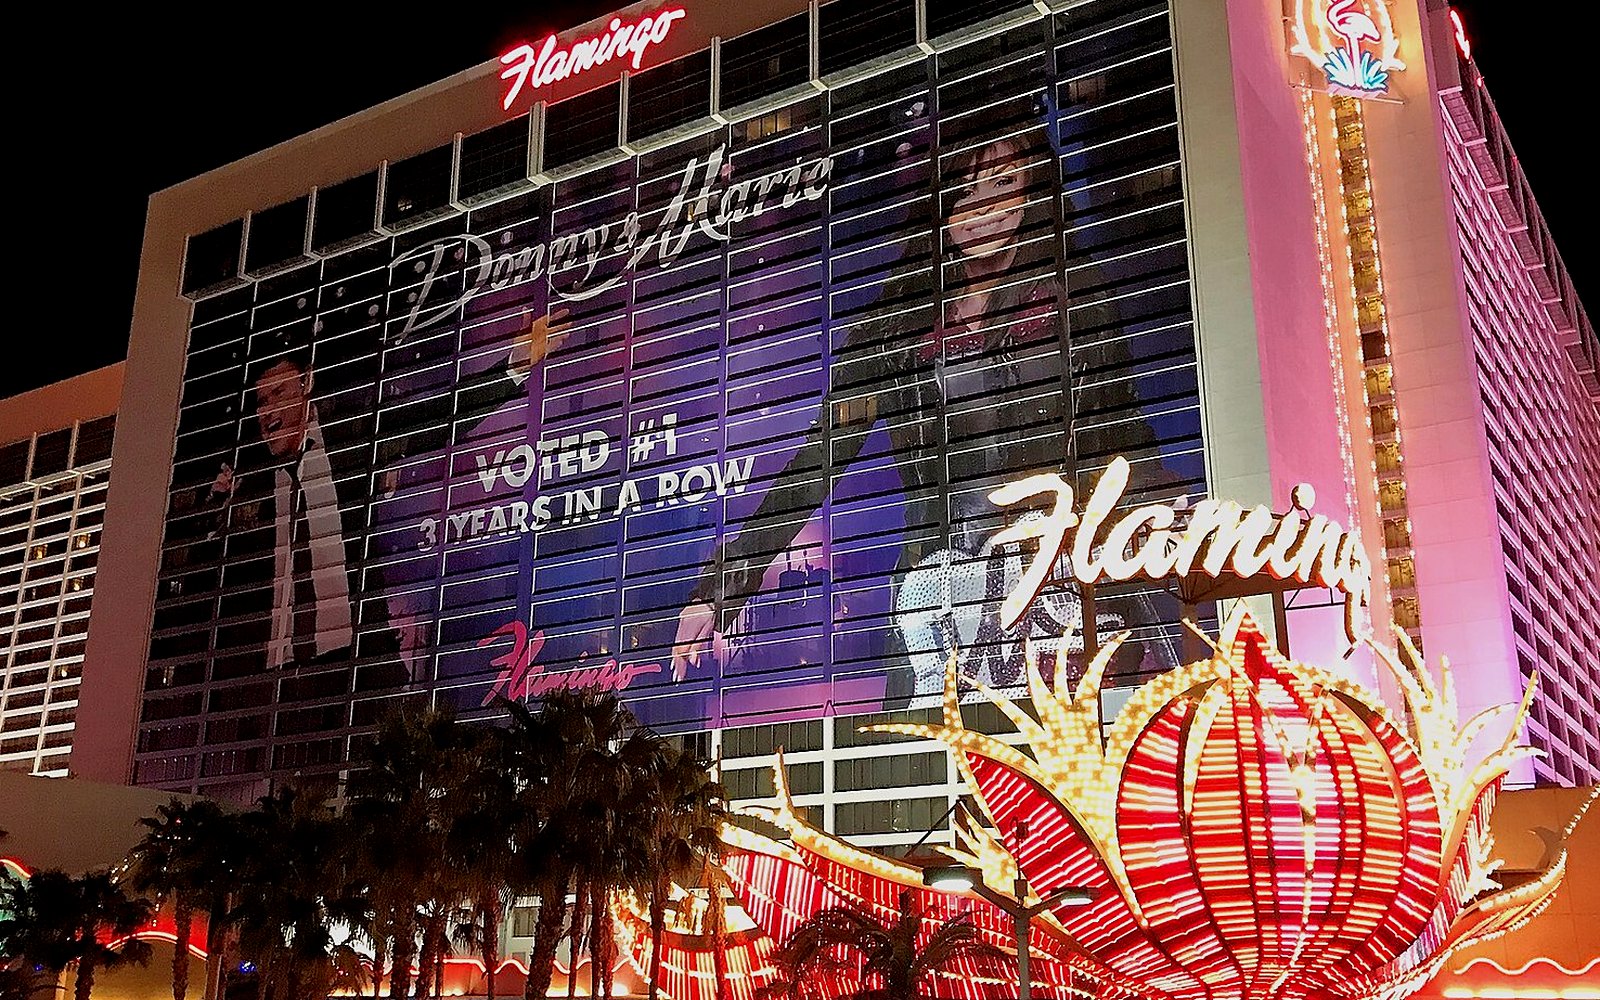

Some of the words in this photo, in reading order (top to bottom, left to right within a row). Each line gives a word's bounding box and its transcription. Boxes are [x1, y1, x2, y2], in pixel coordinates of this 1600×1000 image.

[501, 8, 686, 110] Flamingo
[389, 233, 609, 346] Donny
[628, 142, 834, 274] Marie
[475, 430, 610, 492] VOTED
[630, 412, 678, 463] #1
[417, 517, 437, 552] 3
[450, 496, 551, 545] YEARS
[562, 484, 601, 525] IN
[613, 479, 643, 515] A
[658, 455, 755, 504] ROW
[988, 456, 1372, 646] Flaming
[477, 620, 661, 706] Flamingo
